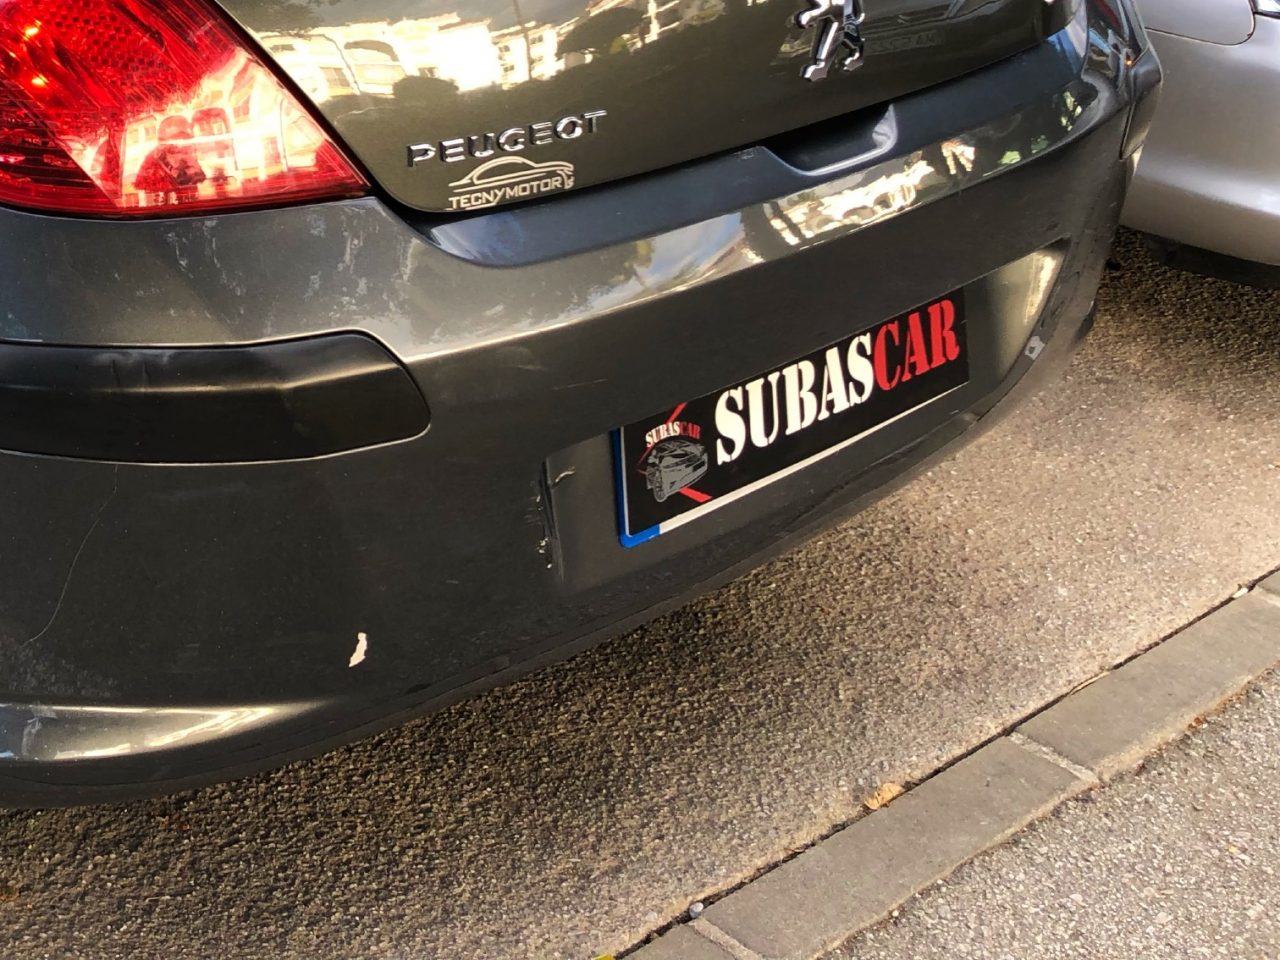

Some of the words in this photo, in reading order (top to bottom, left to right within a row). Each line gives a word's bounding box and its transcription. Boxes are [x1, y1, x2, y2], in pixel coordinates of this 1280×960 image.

[407, 110, 607, 167] PEUGEOT
[715, 299, 960, 465] SUBASCAR
[646, 421, 701, 448] SUBASCAR
